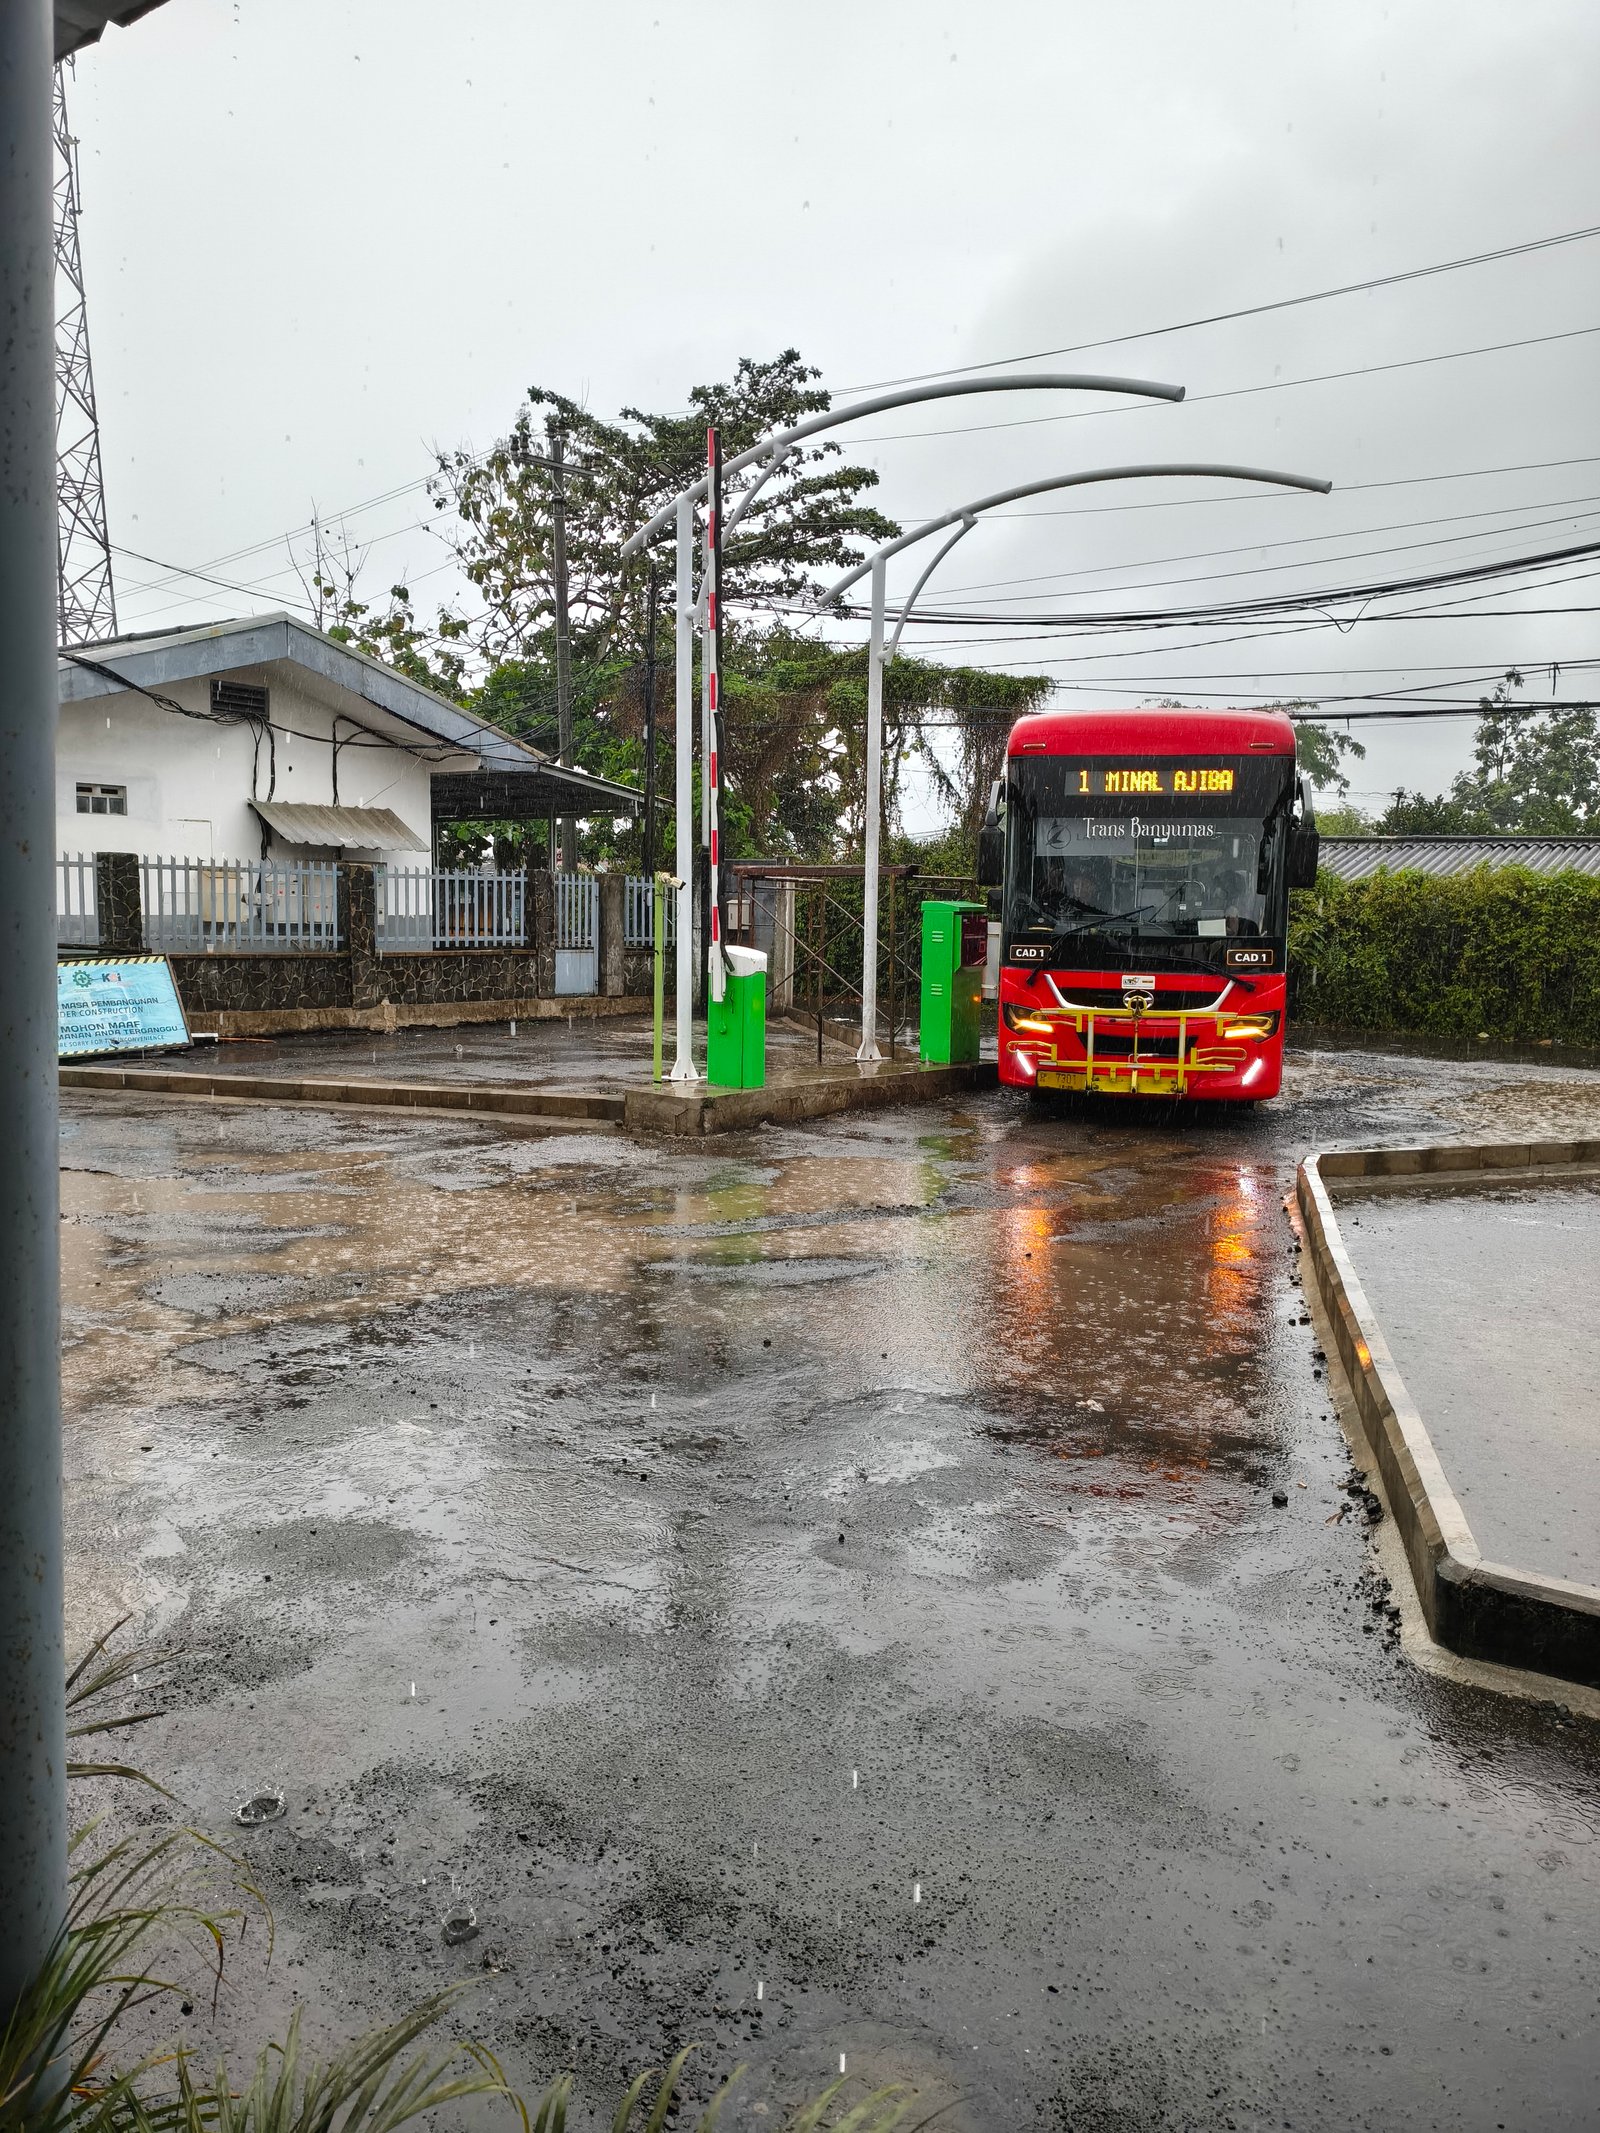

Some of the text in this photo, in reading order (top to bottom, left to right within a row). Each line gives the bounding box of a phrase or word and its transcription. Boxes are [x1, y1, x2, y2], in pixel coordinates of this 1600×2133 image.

[1079, 770, 1090, 792] 1
[1105, 770, 1163, 792] MINAL
[1082, 816, 1214, 839] Trans Banyumas
[1015, 948, 1045, 958] CAD 1
[1234, 953, 1267, 962] CAD 1
[61, 997, 159, 1010] MASA PEMBANGUNAN
[79, 1006, 144, 1017] CONSTRUCTION
[60, 1020, 141, 1033] MOHON MAAF
[94, 1029, 121, 1037] ANDA
[123, 1025, 178, 1035] TERGANGGU
